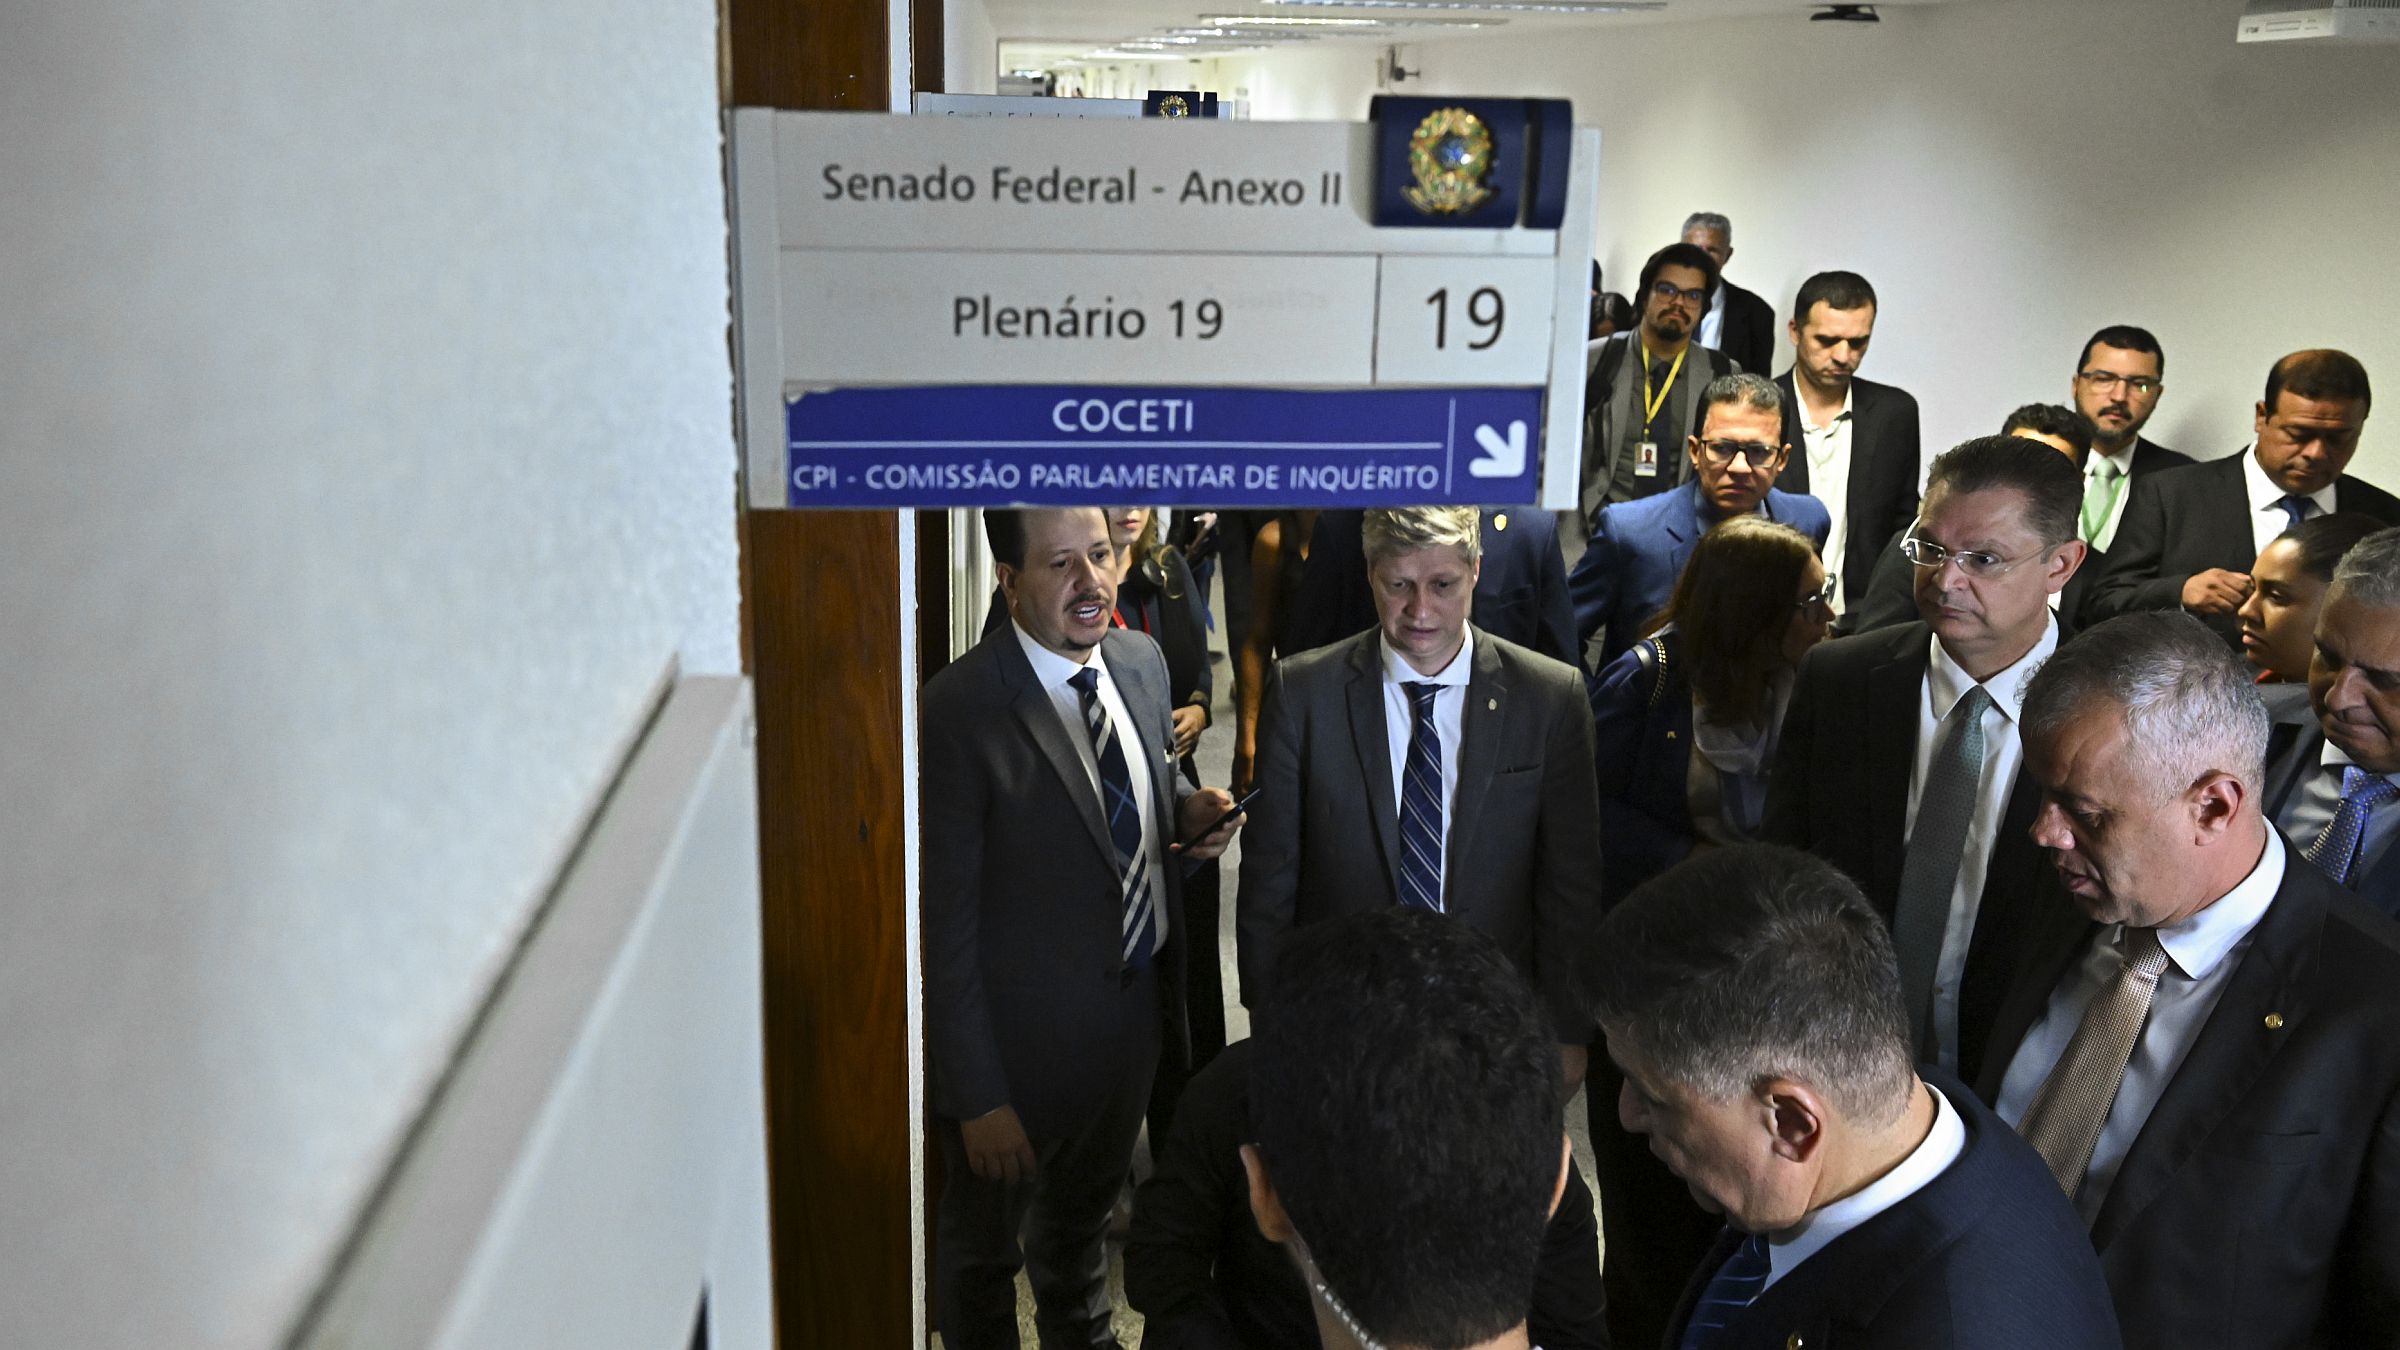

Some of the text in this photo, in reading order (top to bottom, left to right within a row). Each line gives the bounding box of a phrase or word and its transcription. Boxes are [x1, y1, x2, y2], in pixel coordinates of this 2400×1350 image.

[822, 163, 1342, 206] Senado Federal - Anexo II
[952, 294, 1147, 340] Plenário
[1169, 298, 1224, 341] 19
[1426, 286, 1506, 352] 19
[1051, 397, 1195, 434] COCETI
[792, 458, 1440, 494] CPI - COMISSÃO PARLAMENTAR DE INQUÉRITO
